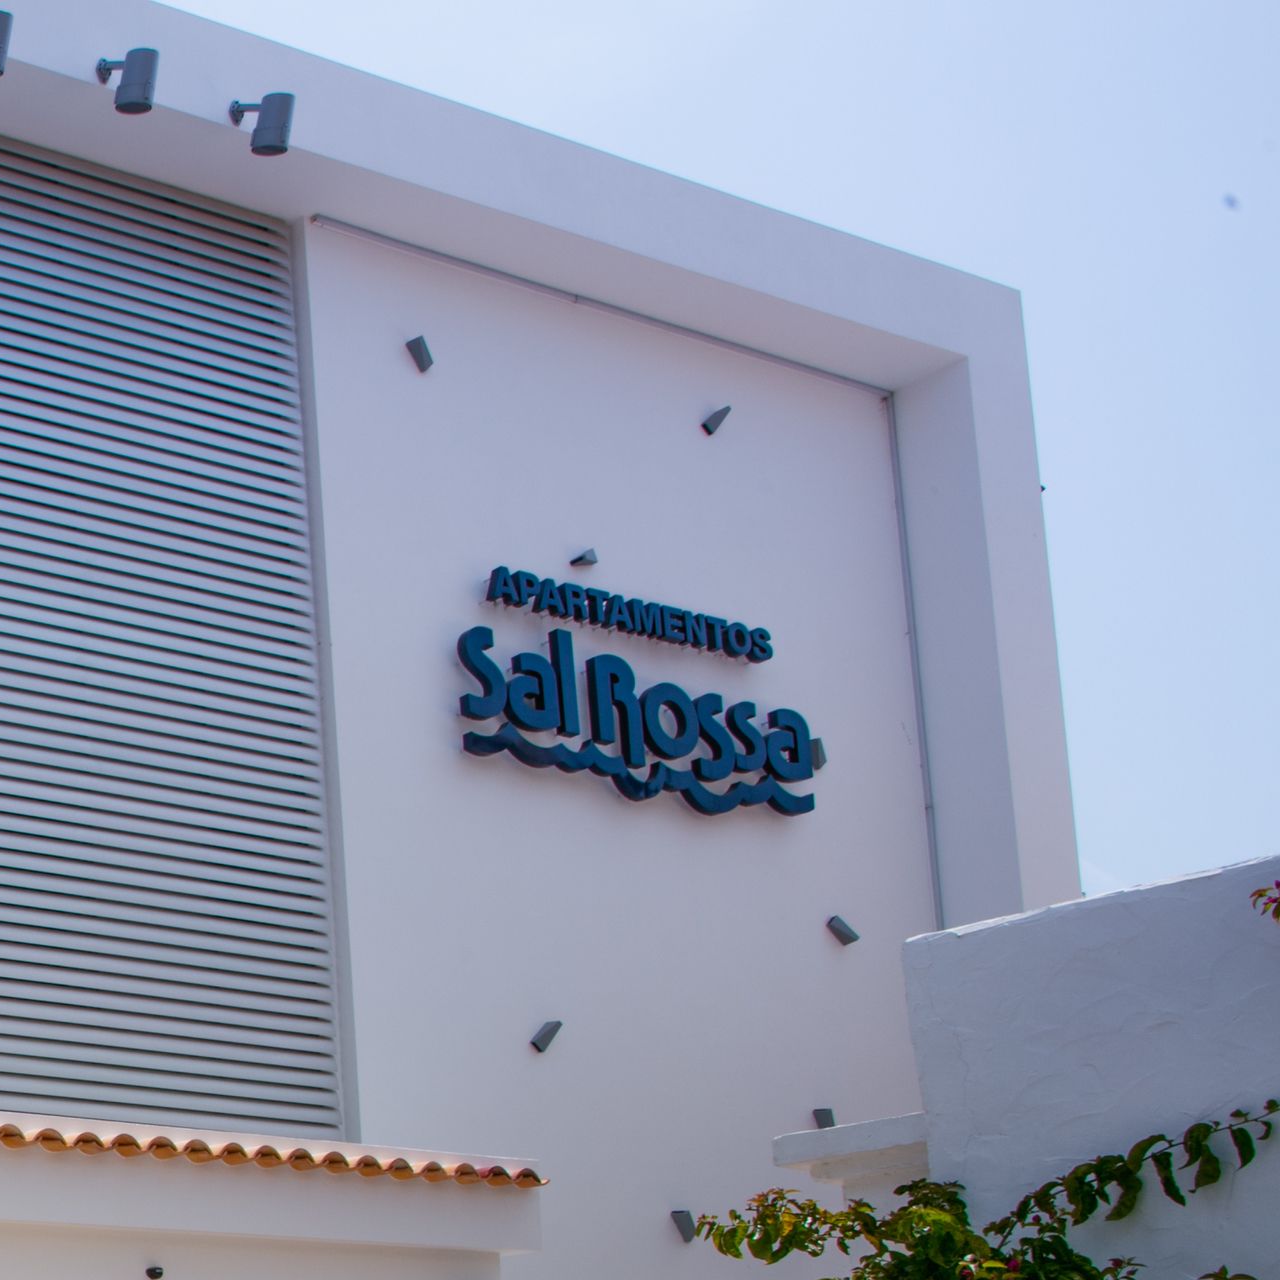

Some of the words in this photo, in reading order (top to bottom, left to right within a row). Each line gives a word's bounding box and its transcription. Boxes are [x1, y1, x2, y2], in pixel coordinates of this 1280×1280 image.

[486, 566, 774, 663] APARTAMENTOS
[457, 626, 579, 737] Sal
[585, 653, 814, 782] Rossa
